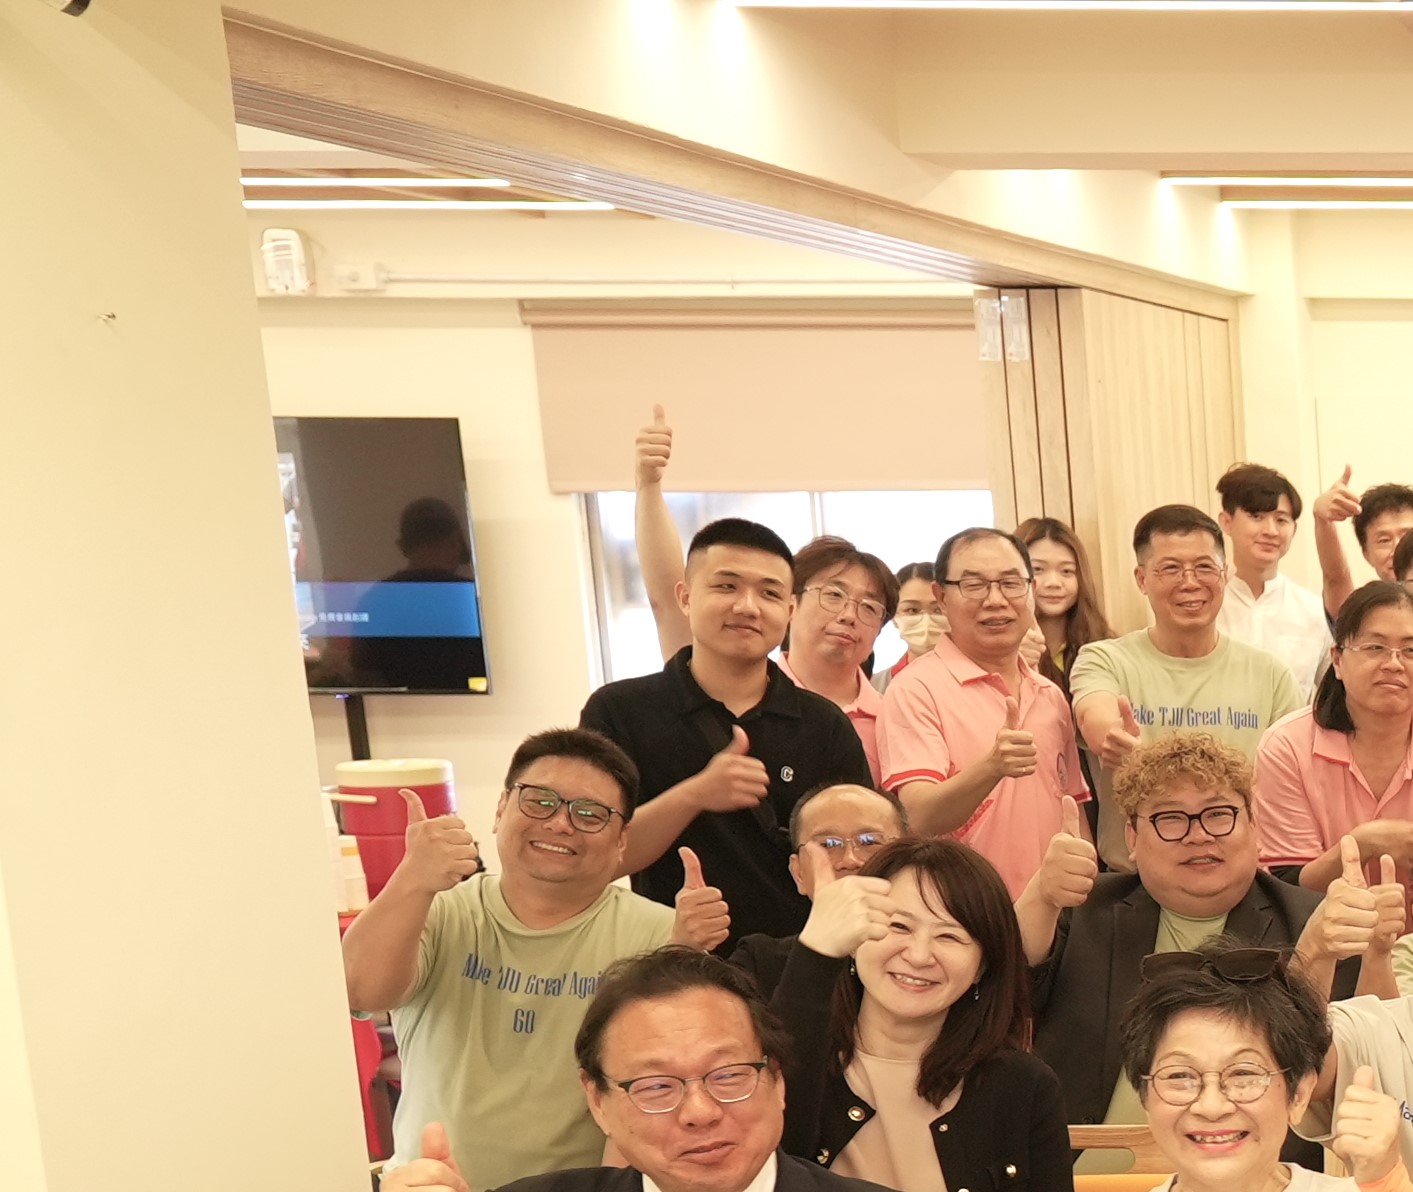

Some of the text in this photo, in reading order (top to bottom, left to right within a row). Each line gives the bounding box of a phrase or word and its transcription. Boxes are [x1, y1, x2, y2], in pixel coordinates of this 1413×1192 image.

[1132, 703, 1258, 730] ake TJU Great Again
[569, 970, 602, 999] Agai
